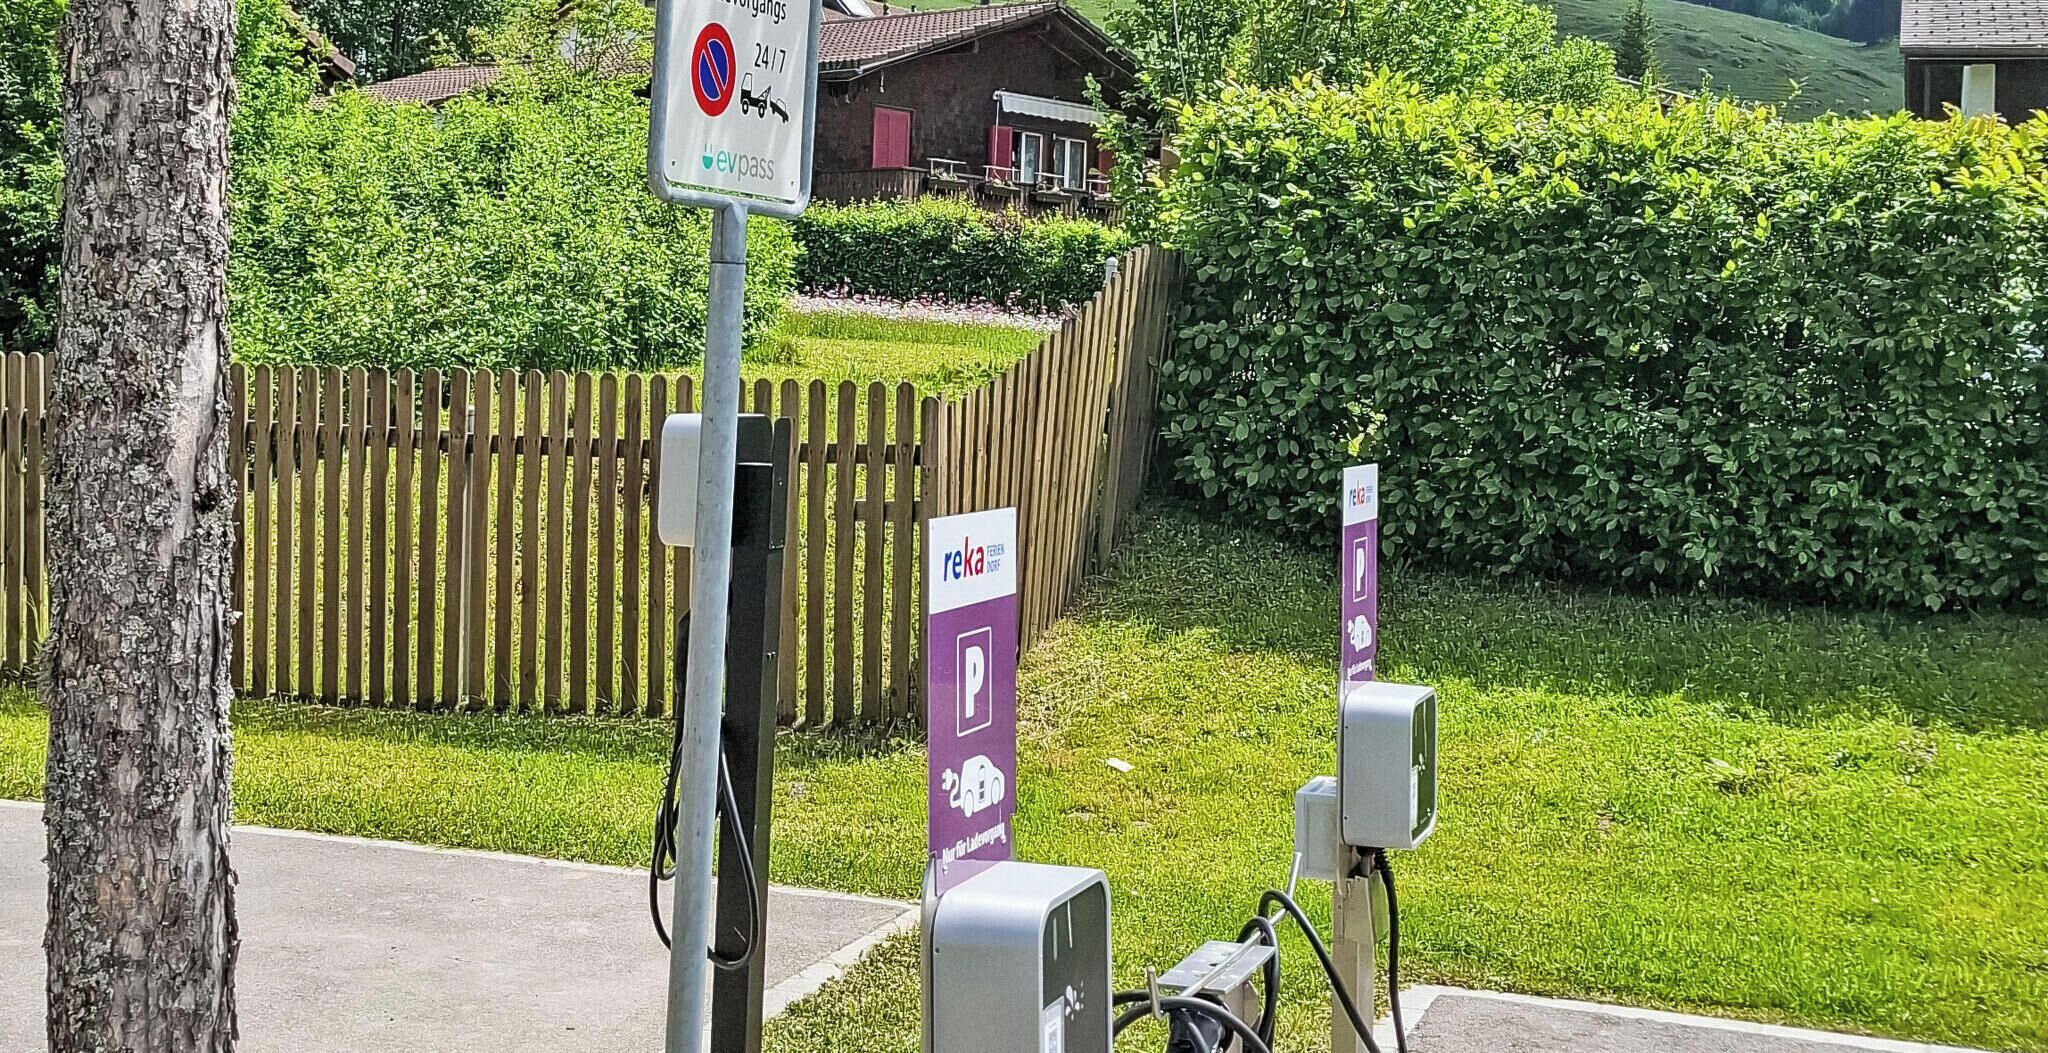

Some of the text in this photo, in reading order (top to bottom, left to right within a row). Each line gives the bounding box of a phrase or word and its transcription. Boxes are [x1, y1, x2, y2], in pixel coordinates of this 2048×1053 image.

[723, 0, 787, 24] rgangs
[716, 149, 775, 182] evpass
[1349, 479, 1366, 508] reka
[943, 535, 985, 582] reka
[1356, 547, 1366, 592] P
[965, 645, 985, 719] P
